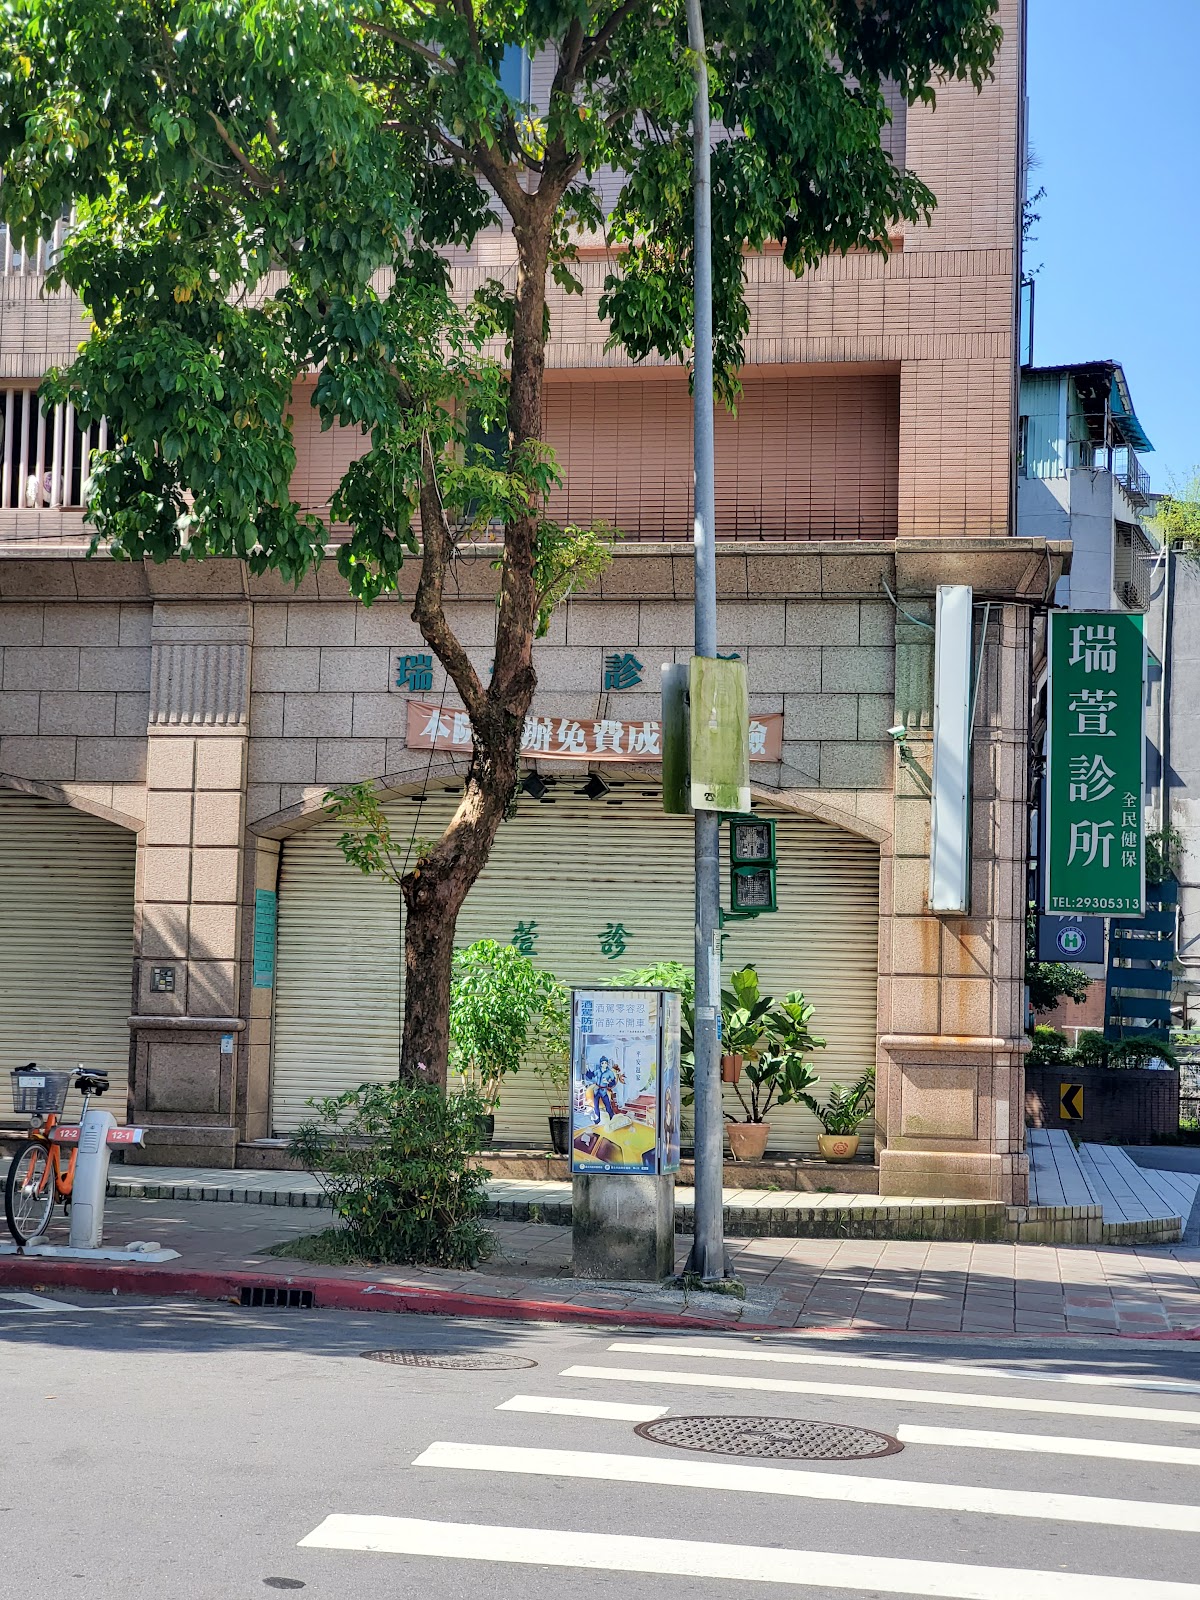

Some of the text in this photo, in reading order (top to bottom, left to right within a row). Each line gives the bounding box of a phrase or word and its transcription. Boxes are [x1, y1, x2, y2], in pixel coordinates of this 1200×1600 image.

[1067, 622, 1118, 869] 瑞萱診所
[1120, 791, 1138, 868] 全民健保
[1052, 897, 1139, 910] TEL:29305313
[595, 1003, 645, 1013] 酒駕零容忍
[595, 1017, 645, 1027] 宿醉不開車
[59, 1129, 78, 1138] 12-2
[111, 1131, 131, 1140] 12-1
